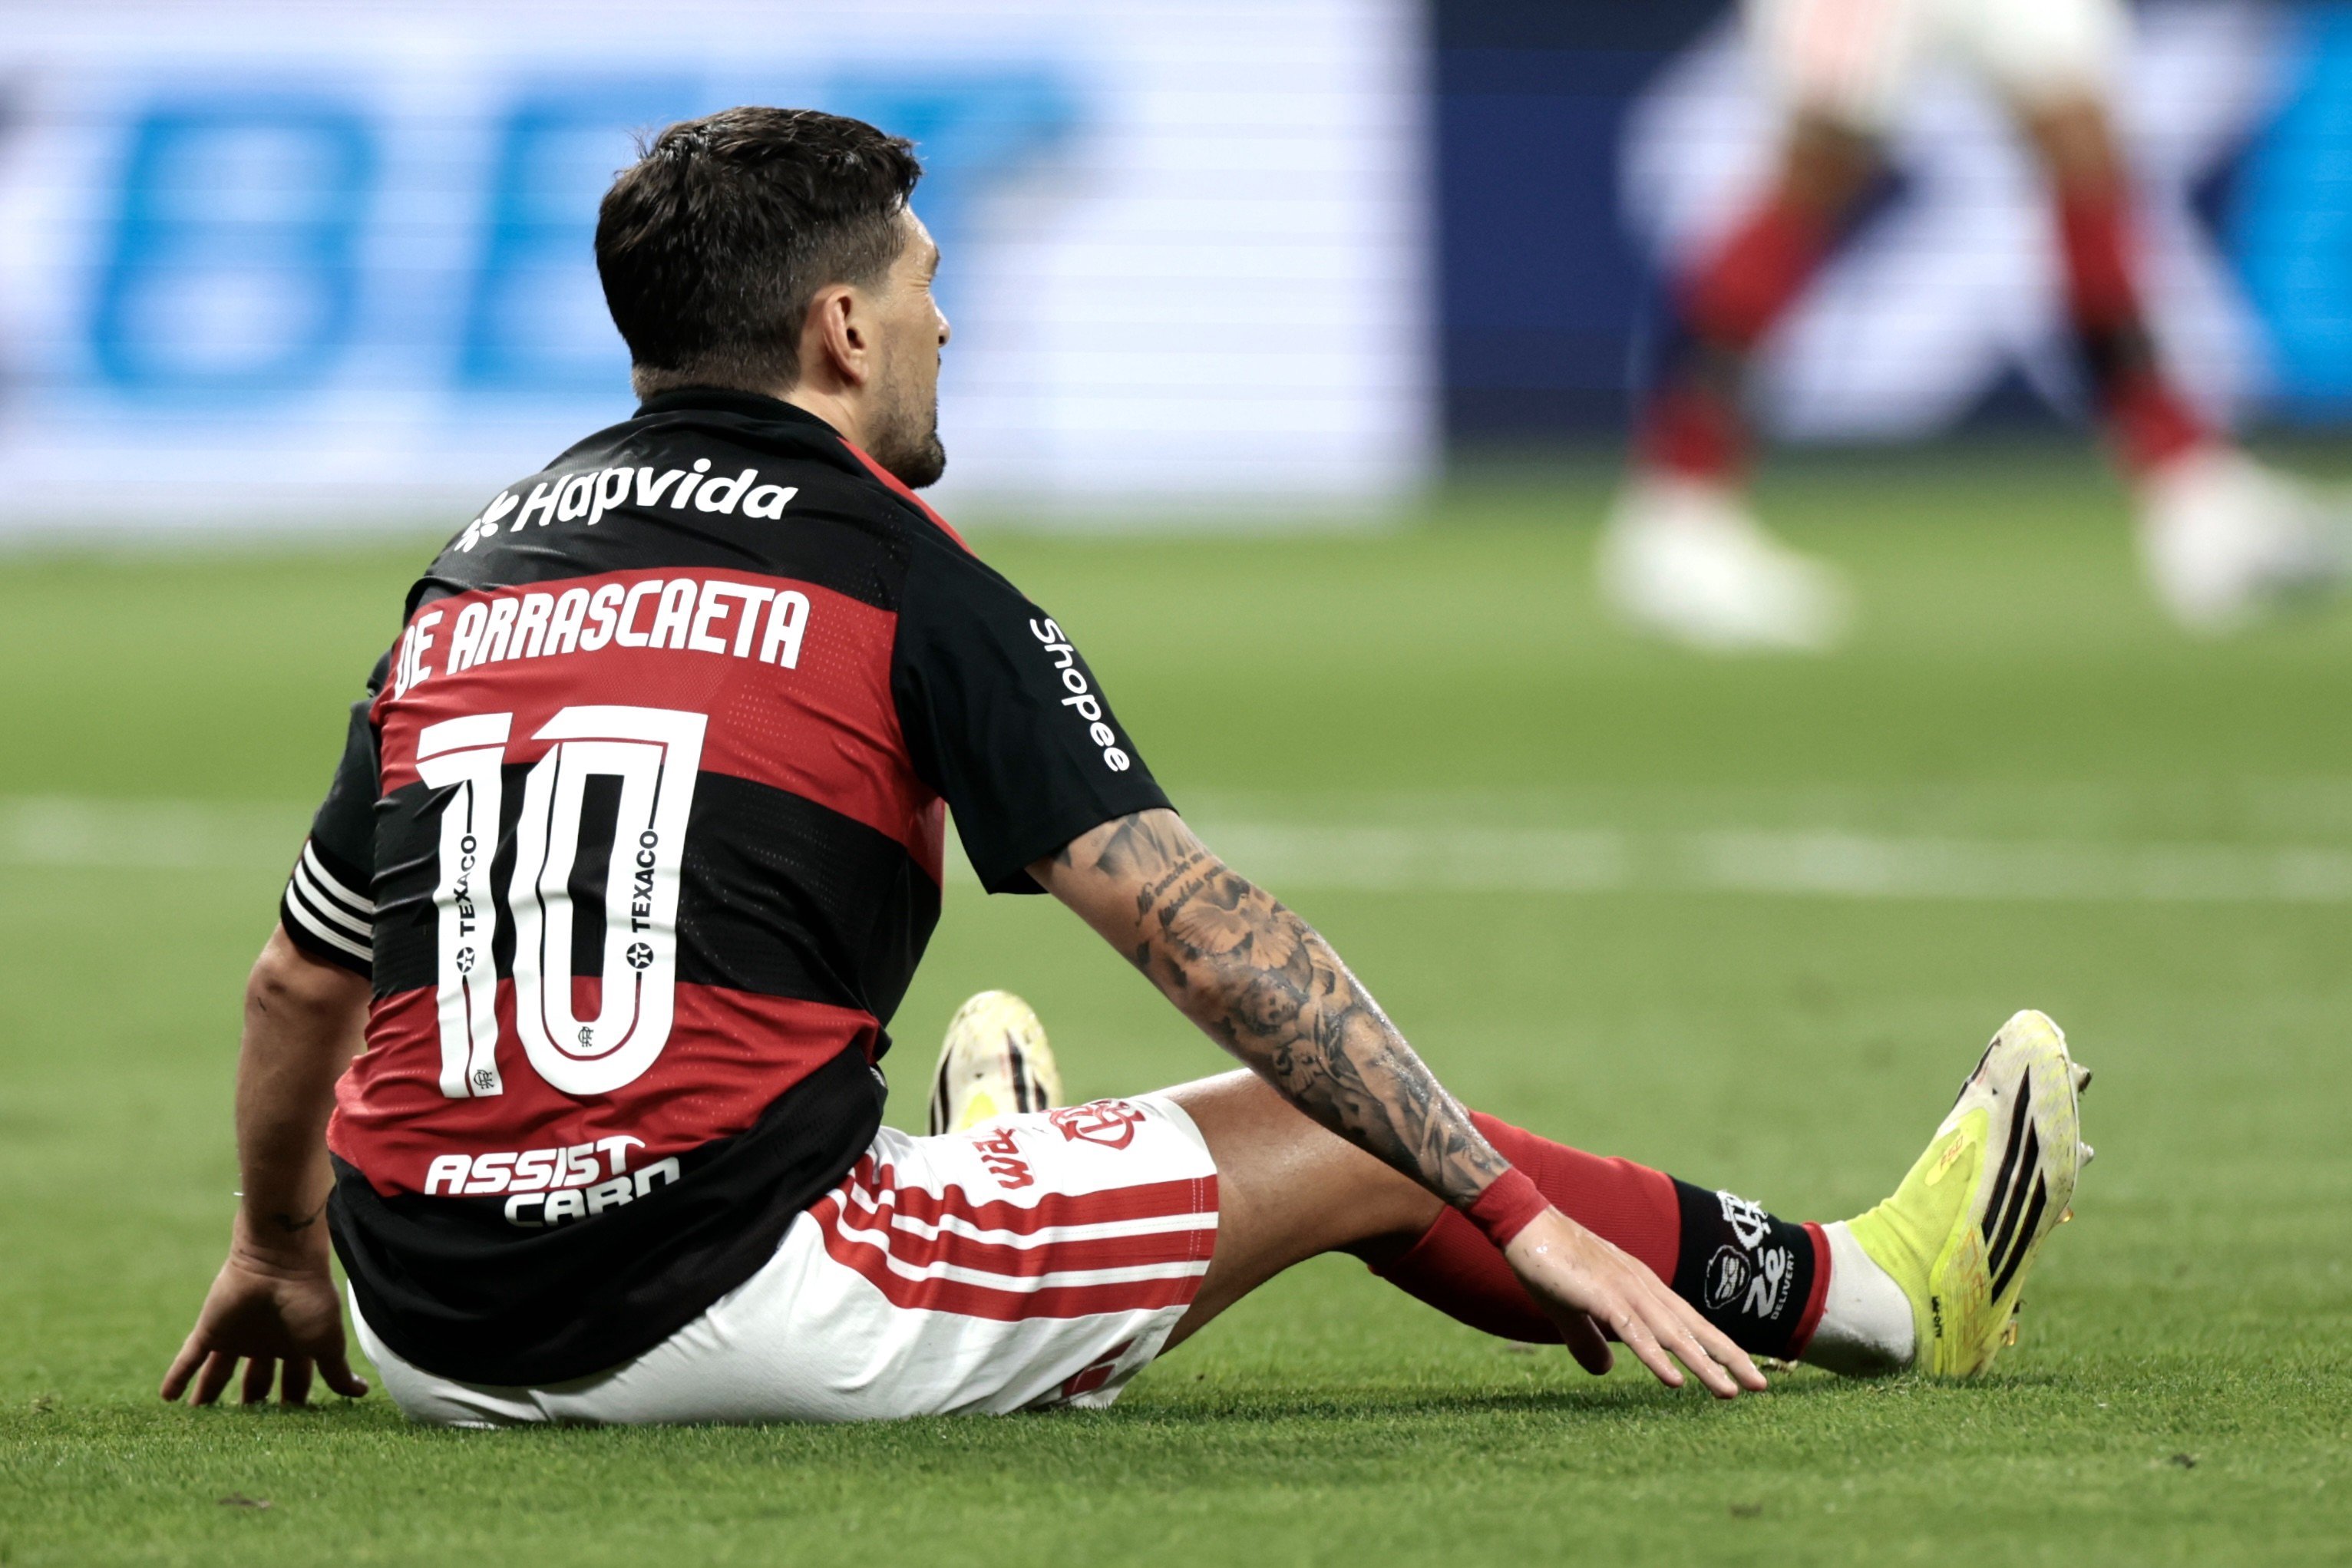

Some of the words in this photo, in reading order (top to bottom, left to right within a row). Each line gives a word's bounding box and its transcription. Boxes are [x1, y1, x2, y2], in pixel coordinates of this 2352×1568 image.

[510, 458, 798, 526] Hapvida
[394, 610, 444, 700] DE
[445, 578, 811, 669] ARRASCAETA
[1029, 618, 1131, 772] Shopee
[415, 705, 709, 1099] 10
[454, 835, 477, 937] TEXACO
[631, 830, 659, 933] TEXACO
[424, 1135, 646, 1195] ASSIST
[1742, 1246, 1786, 1319] Zé
[1770, 1250, 1795, 1320] DELIVERY
